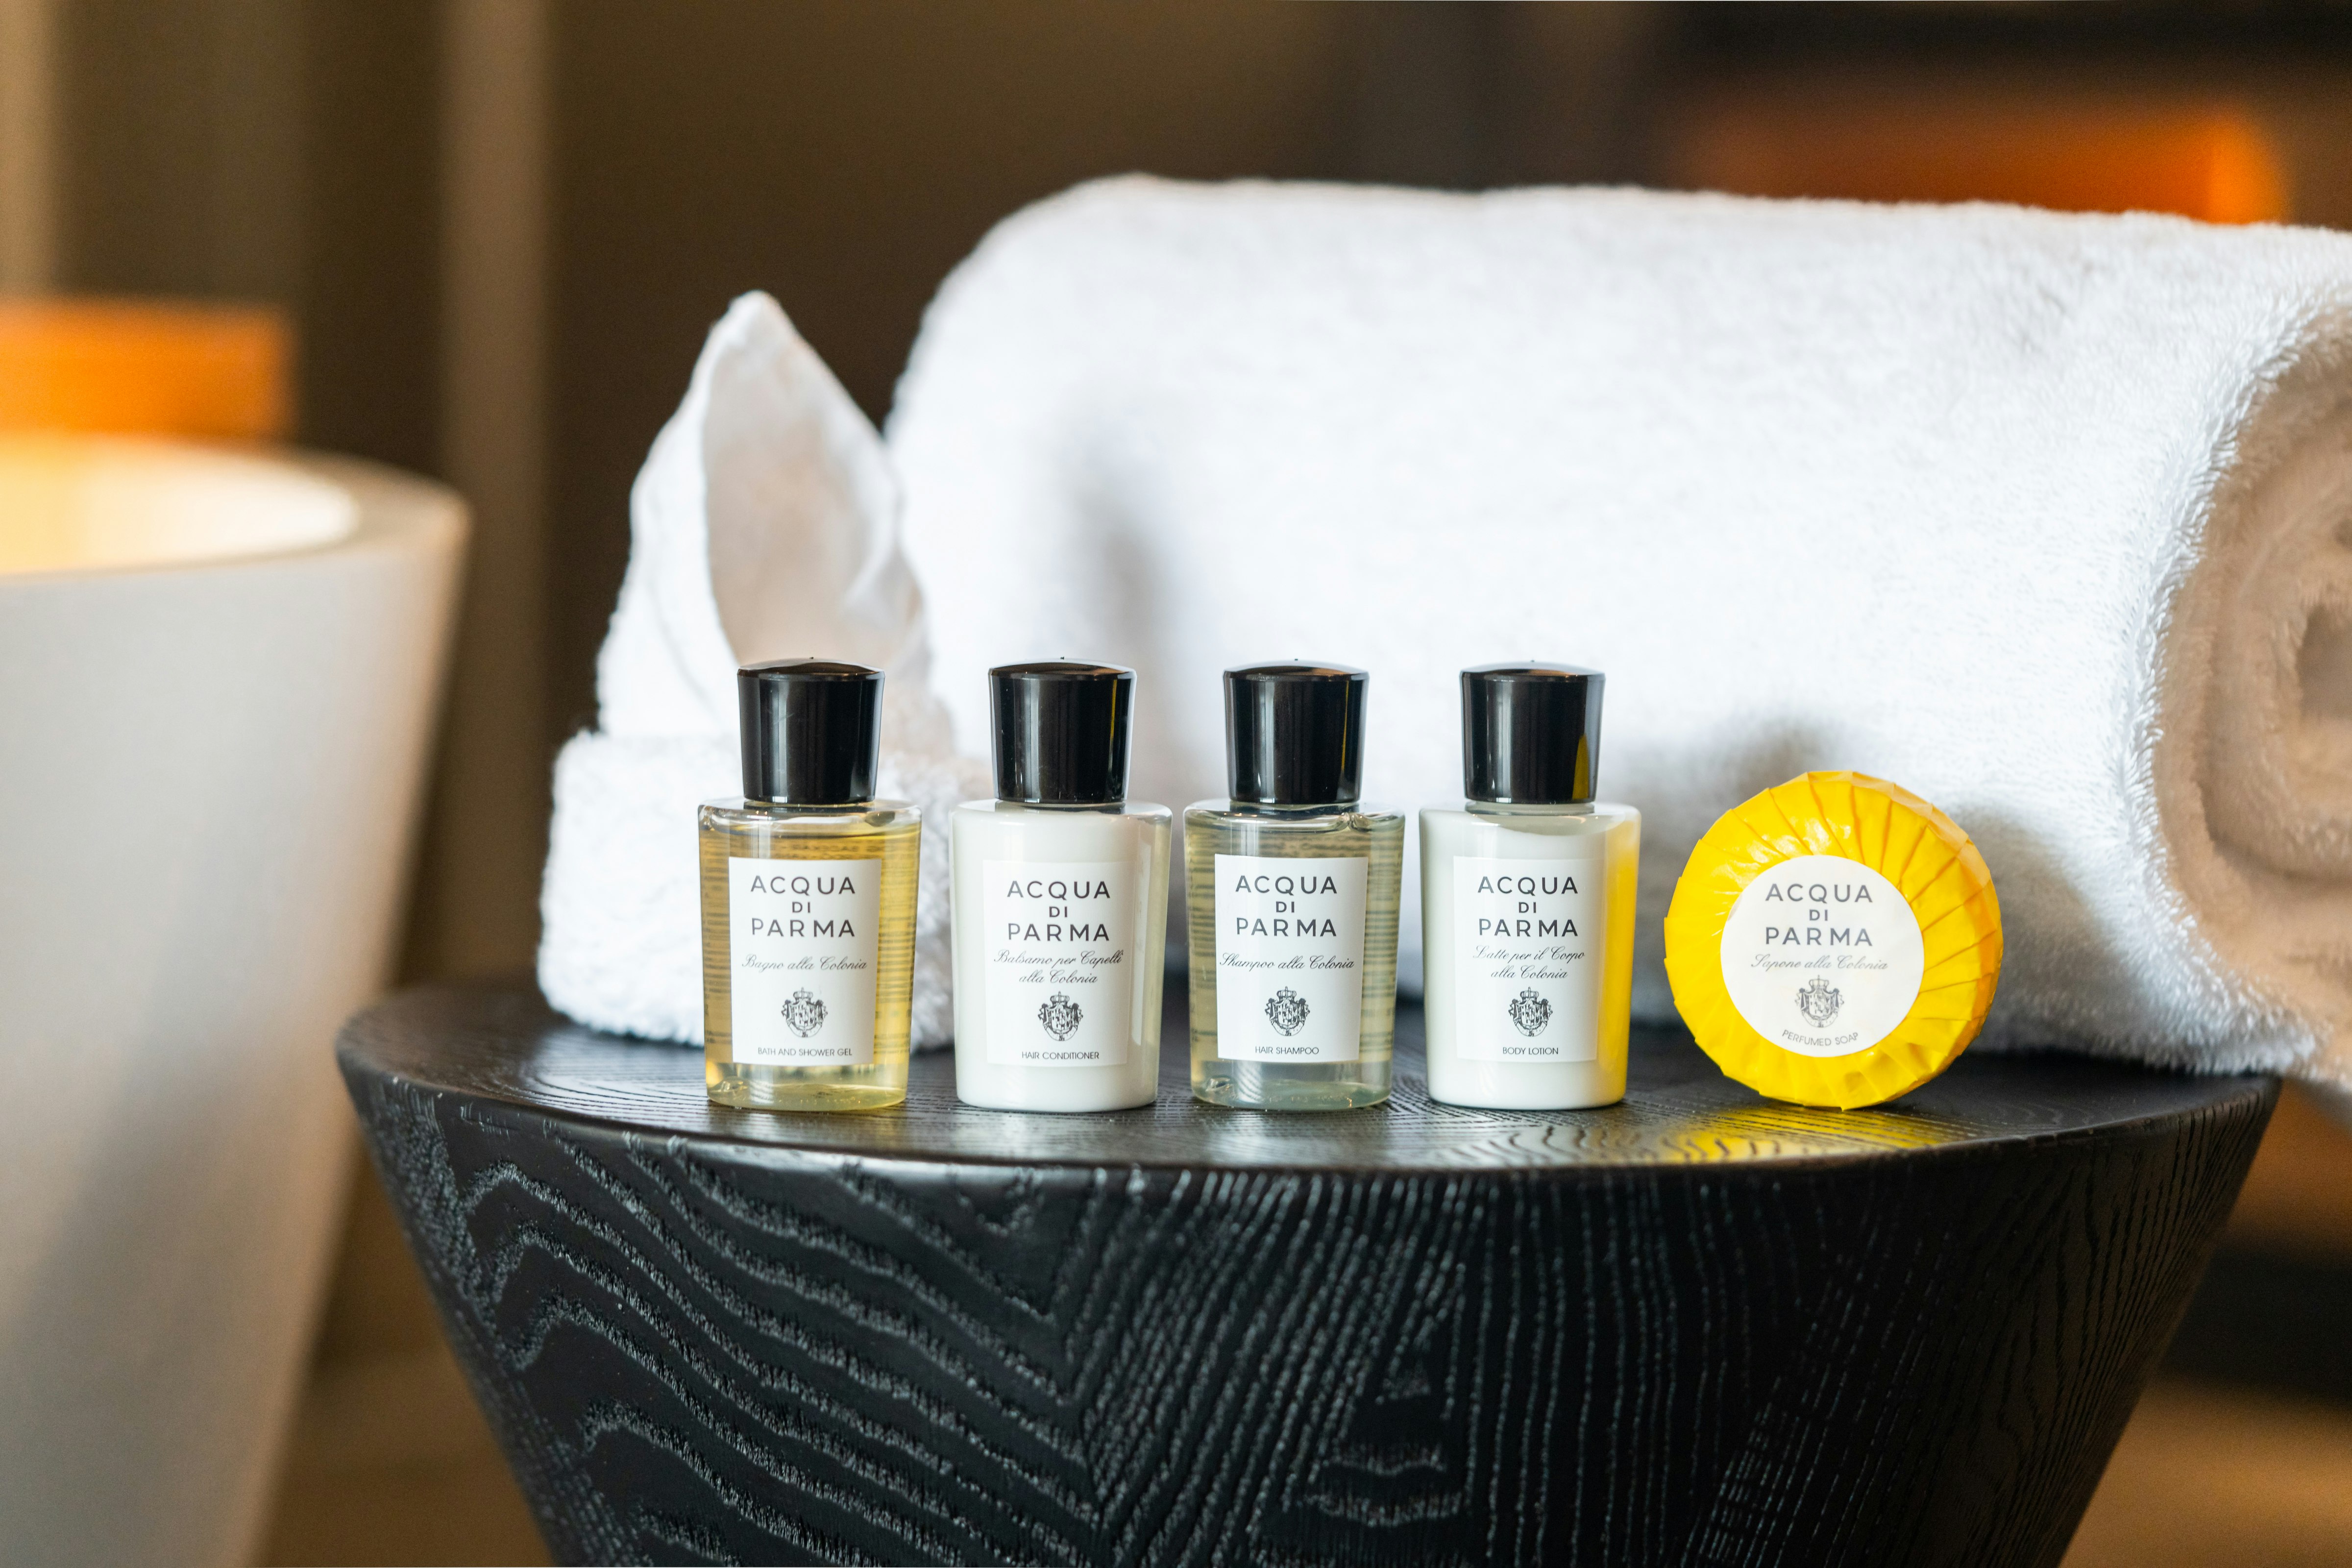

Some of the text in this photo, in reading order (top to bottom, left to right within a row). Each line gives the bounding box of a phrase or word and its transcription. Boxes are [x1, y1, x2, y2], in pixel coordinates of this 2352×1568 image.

[750, 875, 856, 896] ACQUA
[1006, 881, 1111, 901] ACQUA
[1235, 875, 1338, 896] ACQUA
[1477, 876, 1578, 896] ACQUA
[1764, 883, 1873, 904] ACQUA
[792, 901, 811, 913] DI
[1049, 906, 1068, 918] DI
[1275, 901, 1295, 913] DI
[1519, 902, 1537, 914] DI
[1809, 909, 1828, 922] DI
[752, 918, 856, 937] PARMA
[1007, 923, 1110, 942] PARMA
[1237, 917, 1337, 937] PARMA
[1479, 918, 1578, 937] PARMA
[1765, 927, 1873, 947] PARMA
[741, 954, 868, 973] Bagno alla Colonia
[993, 949, 1124, 969] Balsamo per Capelli
[1219, 952, 1355, 972] Shampoo alla Colonia
[1472, 945, 1586, 964] Latte per il Corpo
[1750, 953, 1888, 973] Sapone alla Colonia
[1019, 969, 1098, 984] alla Colonia
[1491, 965, 1568, 980] alla Colonia
[1782, 1029, 1859, 1047] PERFUMED SOAP
[758, 1047, 853, 1057] BATH AND SHOWER GEL
[1022, 1051, 1100, 1060] HAIR CONDITIONER
[1255, 1046, 1320, 1055] HAIR SHAMPOO
[1502, 1047, 1559, 1055] BODY LOTION
